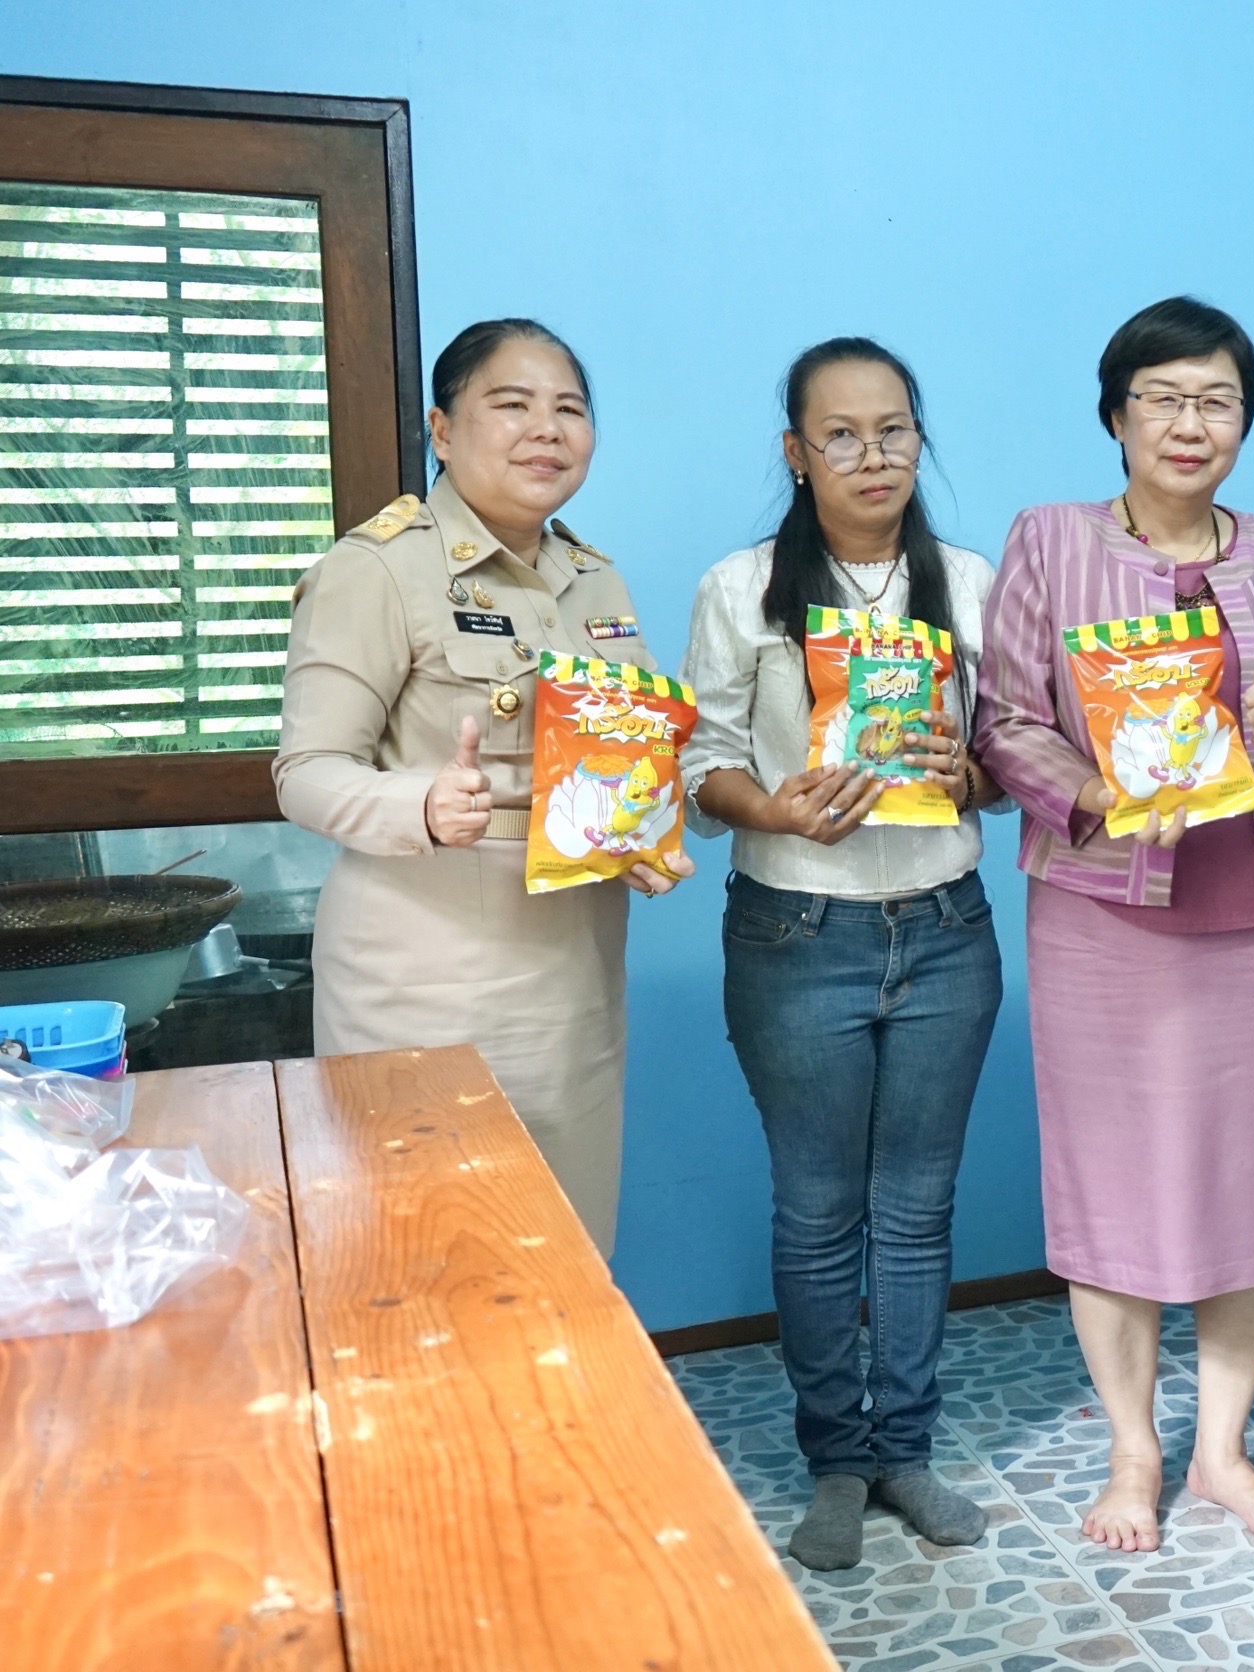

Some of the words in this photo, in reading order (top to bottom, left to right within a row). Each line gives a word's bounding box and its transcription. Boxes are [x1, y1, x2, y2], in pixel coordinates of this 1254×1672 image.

[1113, 633, 1147, 643] BANAN
[632, 680, 653, 689] CHIP
[654, 745, 675, 755] KRO
